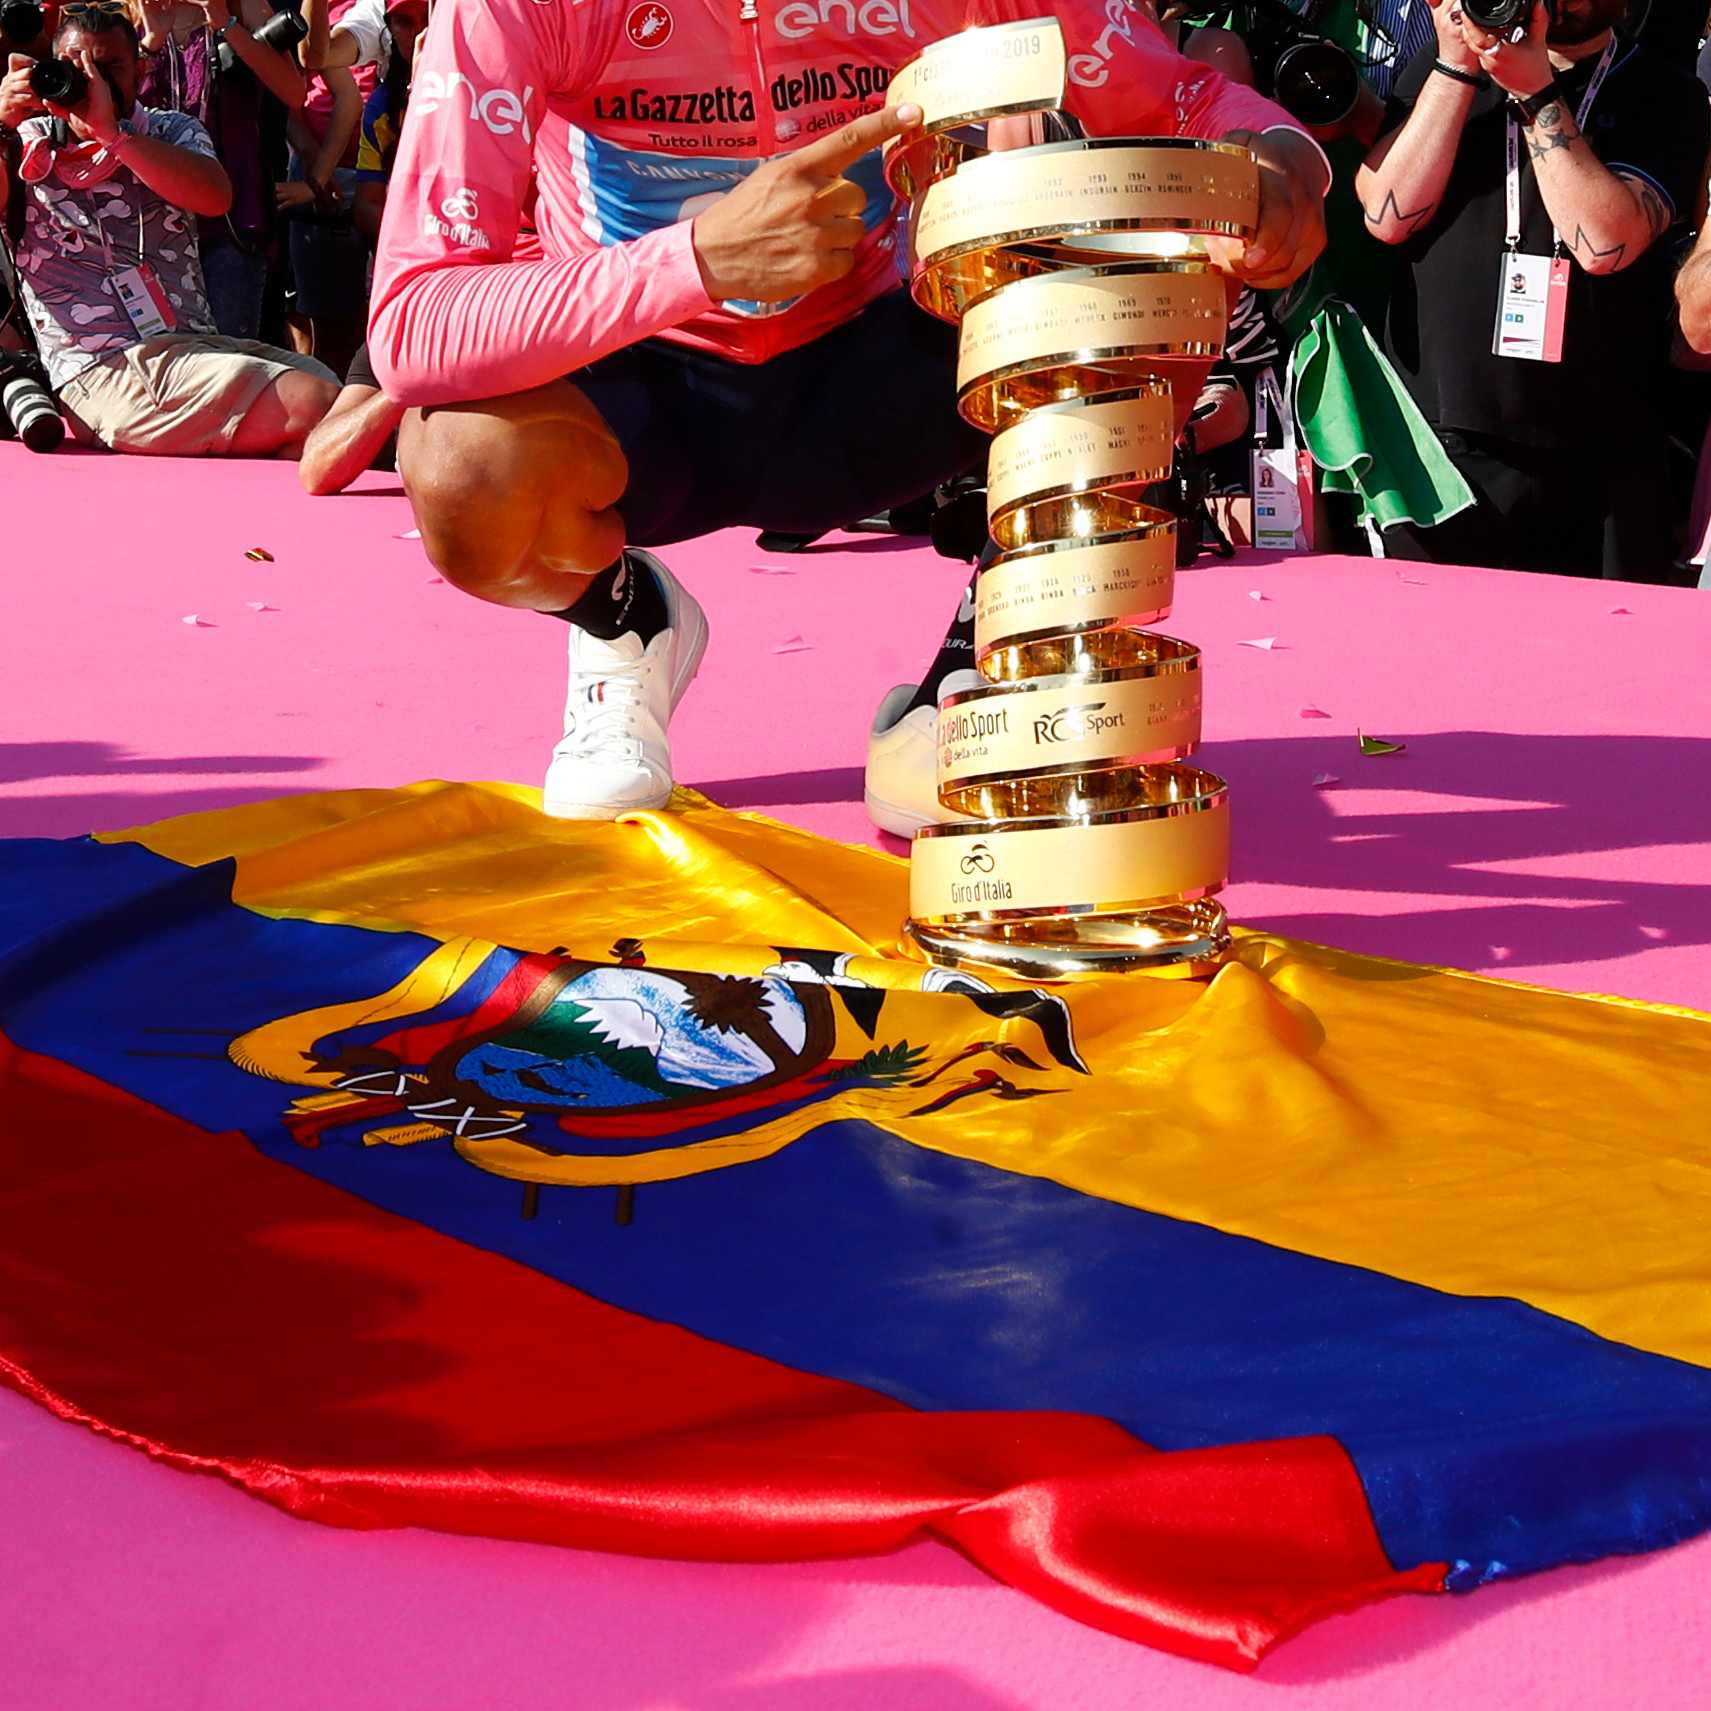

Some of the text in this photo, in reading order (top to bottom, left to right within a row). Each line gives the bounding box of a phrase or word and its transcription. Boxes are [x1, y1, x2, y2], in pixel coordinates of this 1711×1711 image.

[1003, 35, 1041, 59] 2019
[594, 91, 627, 120] La
[630, 88, 756, 124] Gazzetta
[771, 65, 835, 112] dello
[414, 70, 534, 144] enel
[806, 111, 846, 133] della
[648, 133, 758, 148] Tutto il rosa
[947, 717, 969, 745] dello
[970, 707, 1009, 742] Sport
[1087, 712, 1125, 735] Sport
[972, 745, 989, 757] vita
[951, 879, 1013, 904] Giro d'Italia
